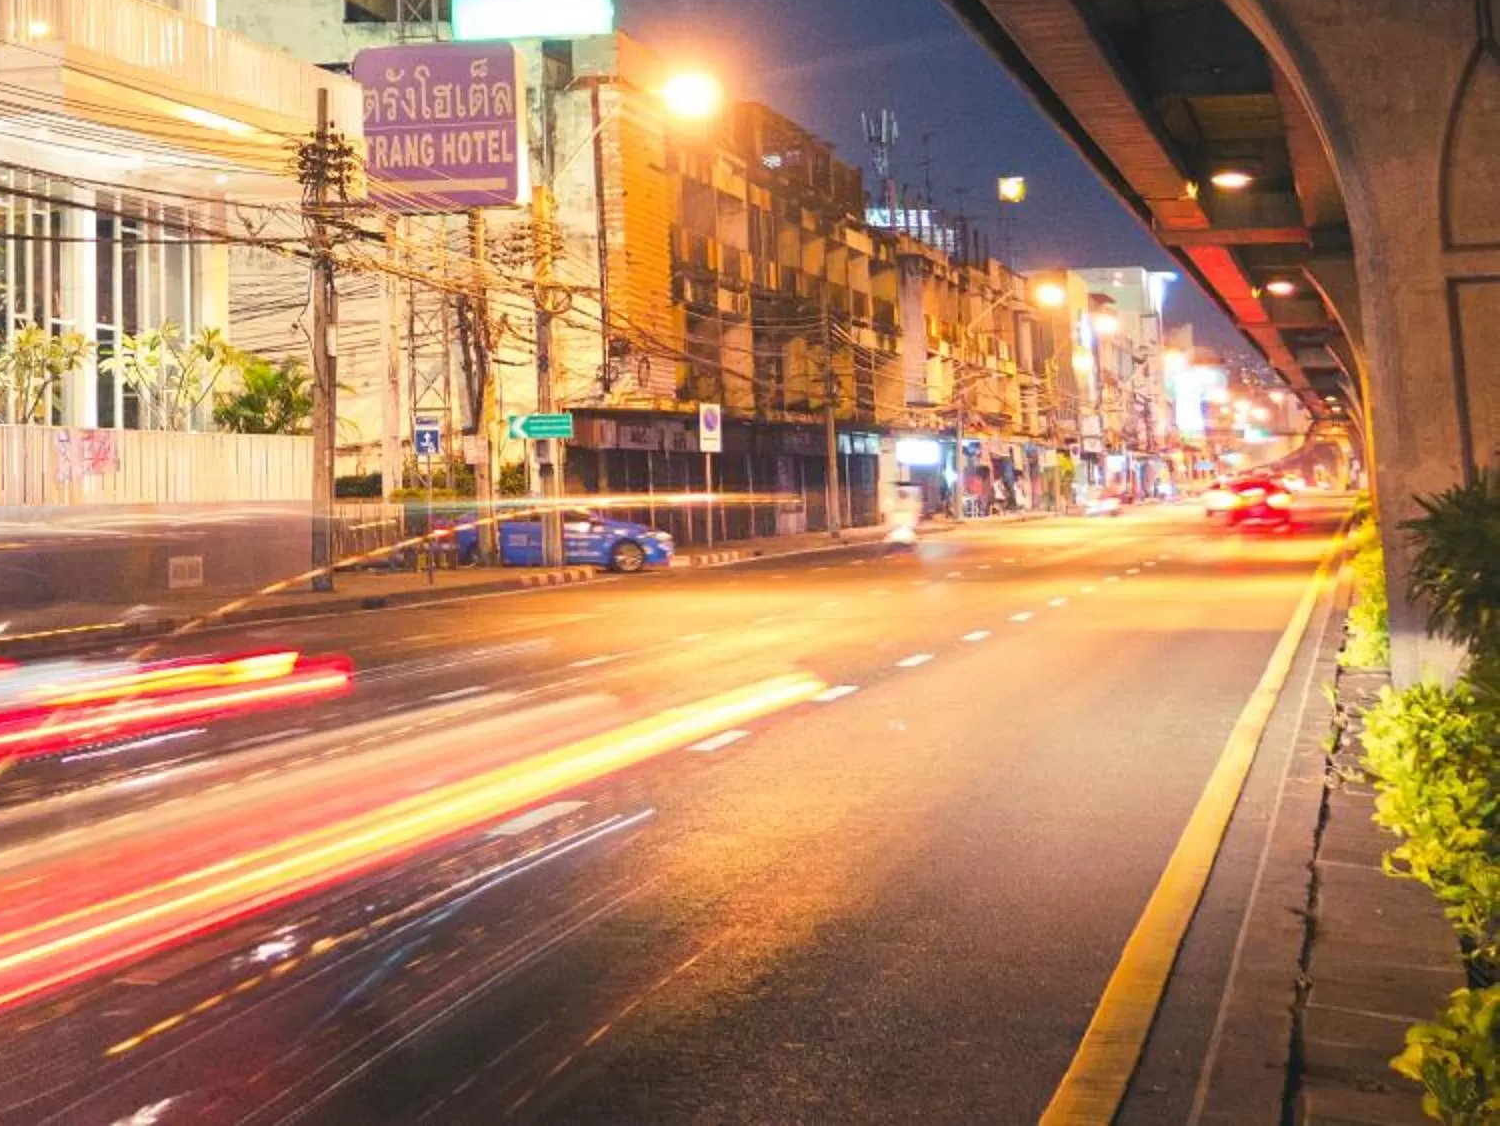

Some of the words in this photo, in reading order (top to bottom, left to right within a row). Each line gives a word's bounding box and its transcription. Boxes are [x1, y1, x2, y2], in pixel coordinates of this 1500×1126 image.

[363, 58, 514, 123] ตรังโฮเต็ล
[441, 128, 515, 165] HOTEL
